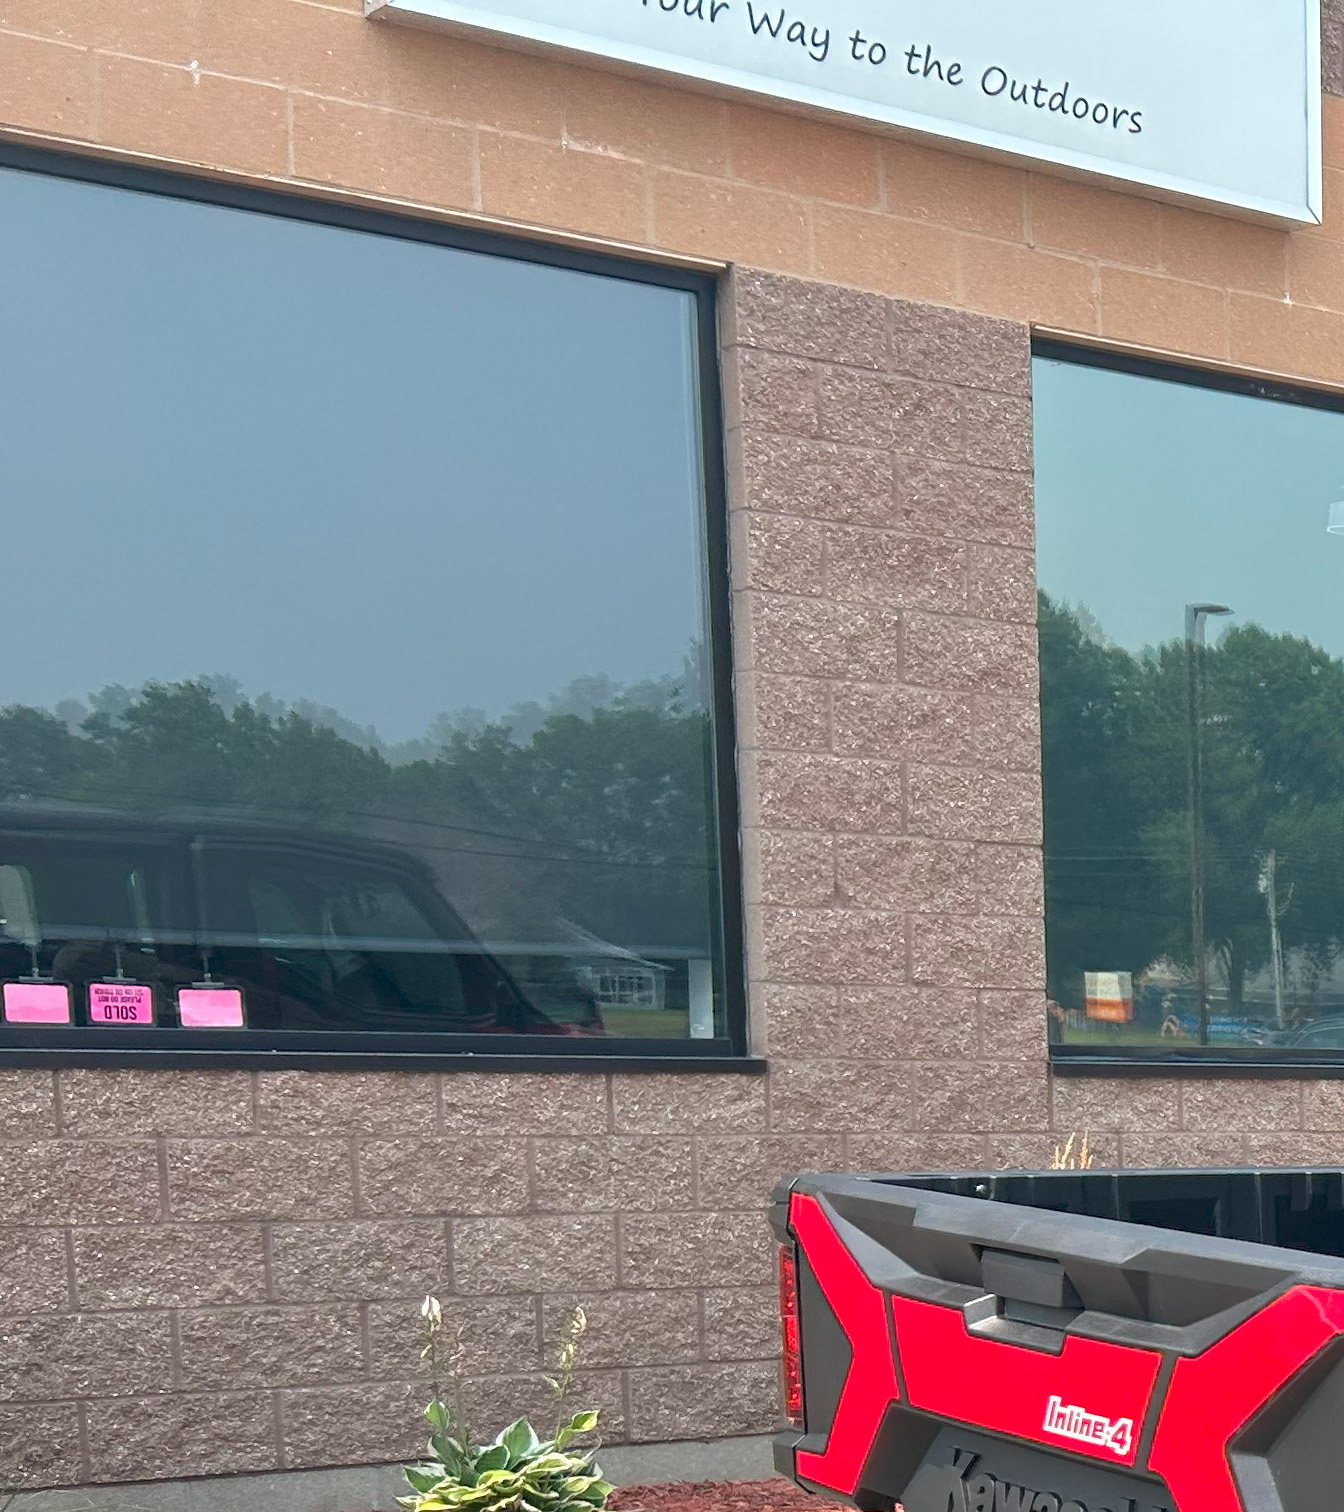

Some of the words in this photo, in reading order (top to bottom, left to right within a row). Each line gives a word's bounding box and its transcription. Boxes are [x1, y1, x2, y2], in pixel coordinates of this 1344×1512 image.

[747, 1, 830, 62] Way
[849, 30, 887, 65] to
[904, 44, 964, 86] the
[980, 66, 1143, 133] Outdoors
[104, 1005, 137, 1020] SOLD
[1042, 1394, 1134, 1456] Inline-4
